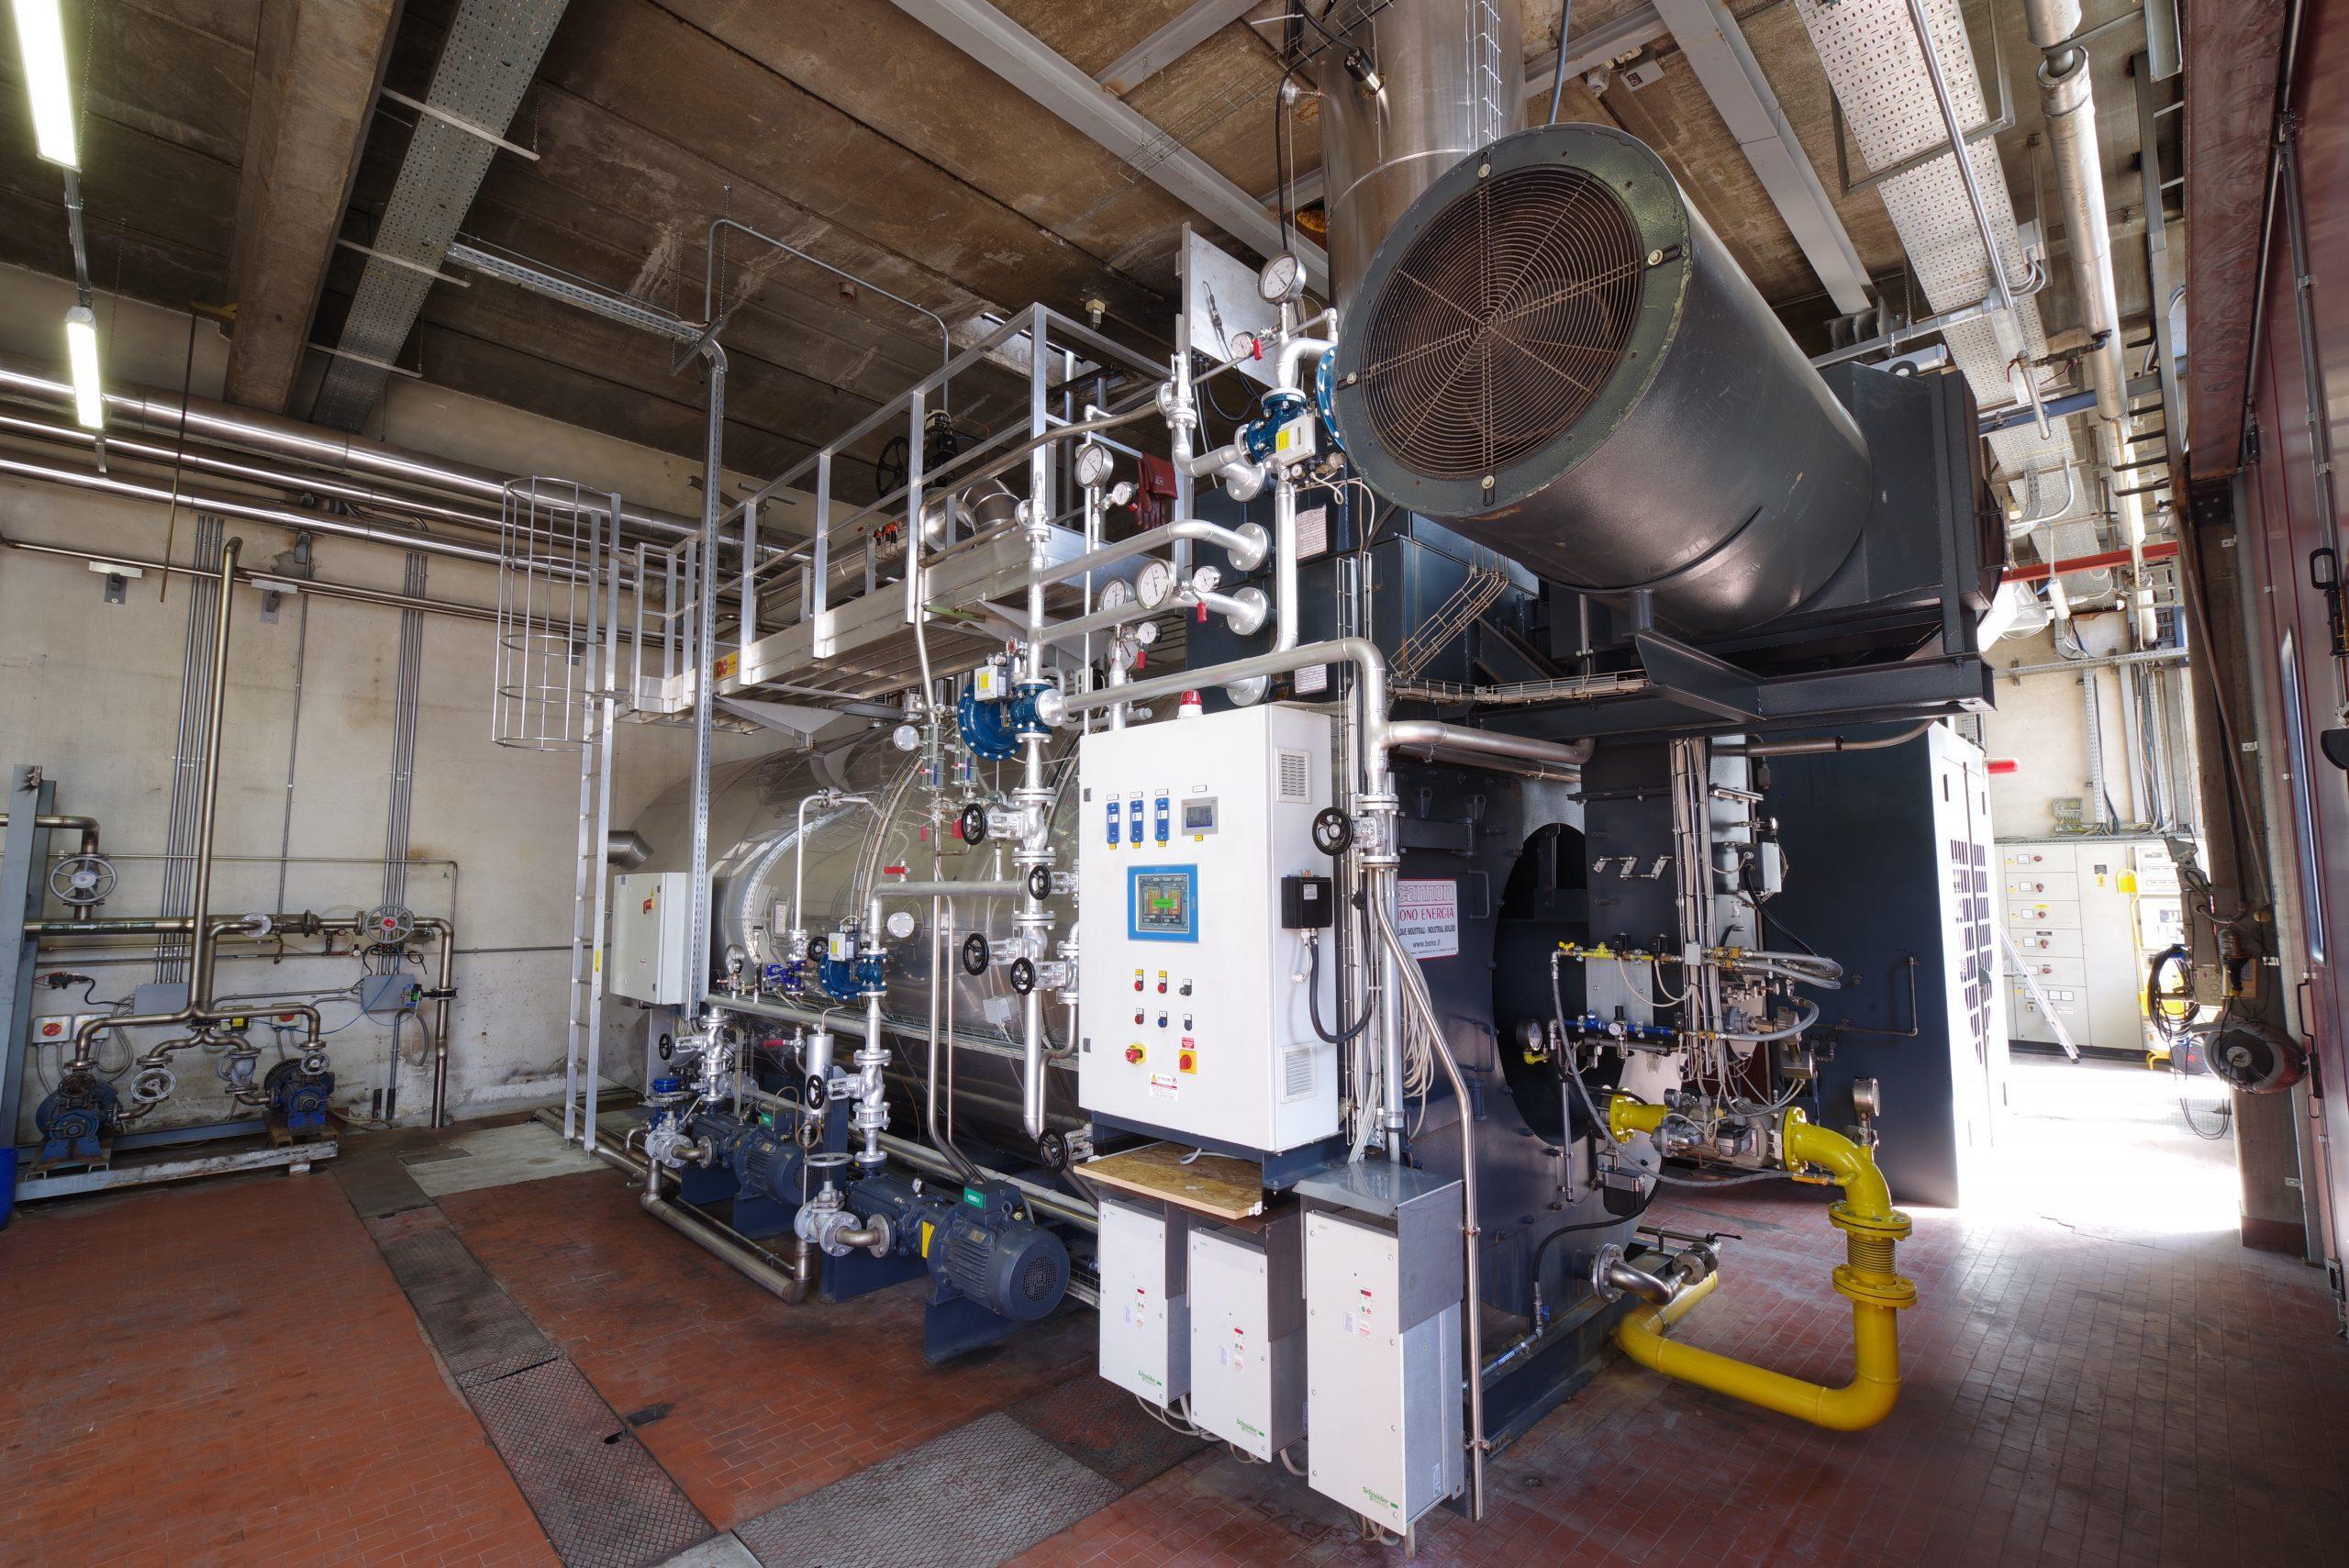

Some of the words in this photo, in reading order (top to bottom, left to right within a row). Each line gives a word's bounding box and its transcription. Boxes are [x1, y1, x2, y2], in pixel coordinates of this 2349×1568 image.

[1397, 885, 1454, 902] cannon
[1421, 906, 1454, 920] ENERGIA
[1363, 1486, 1388, 1503] Schneider
